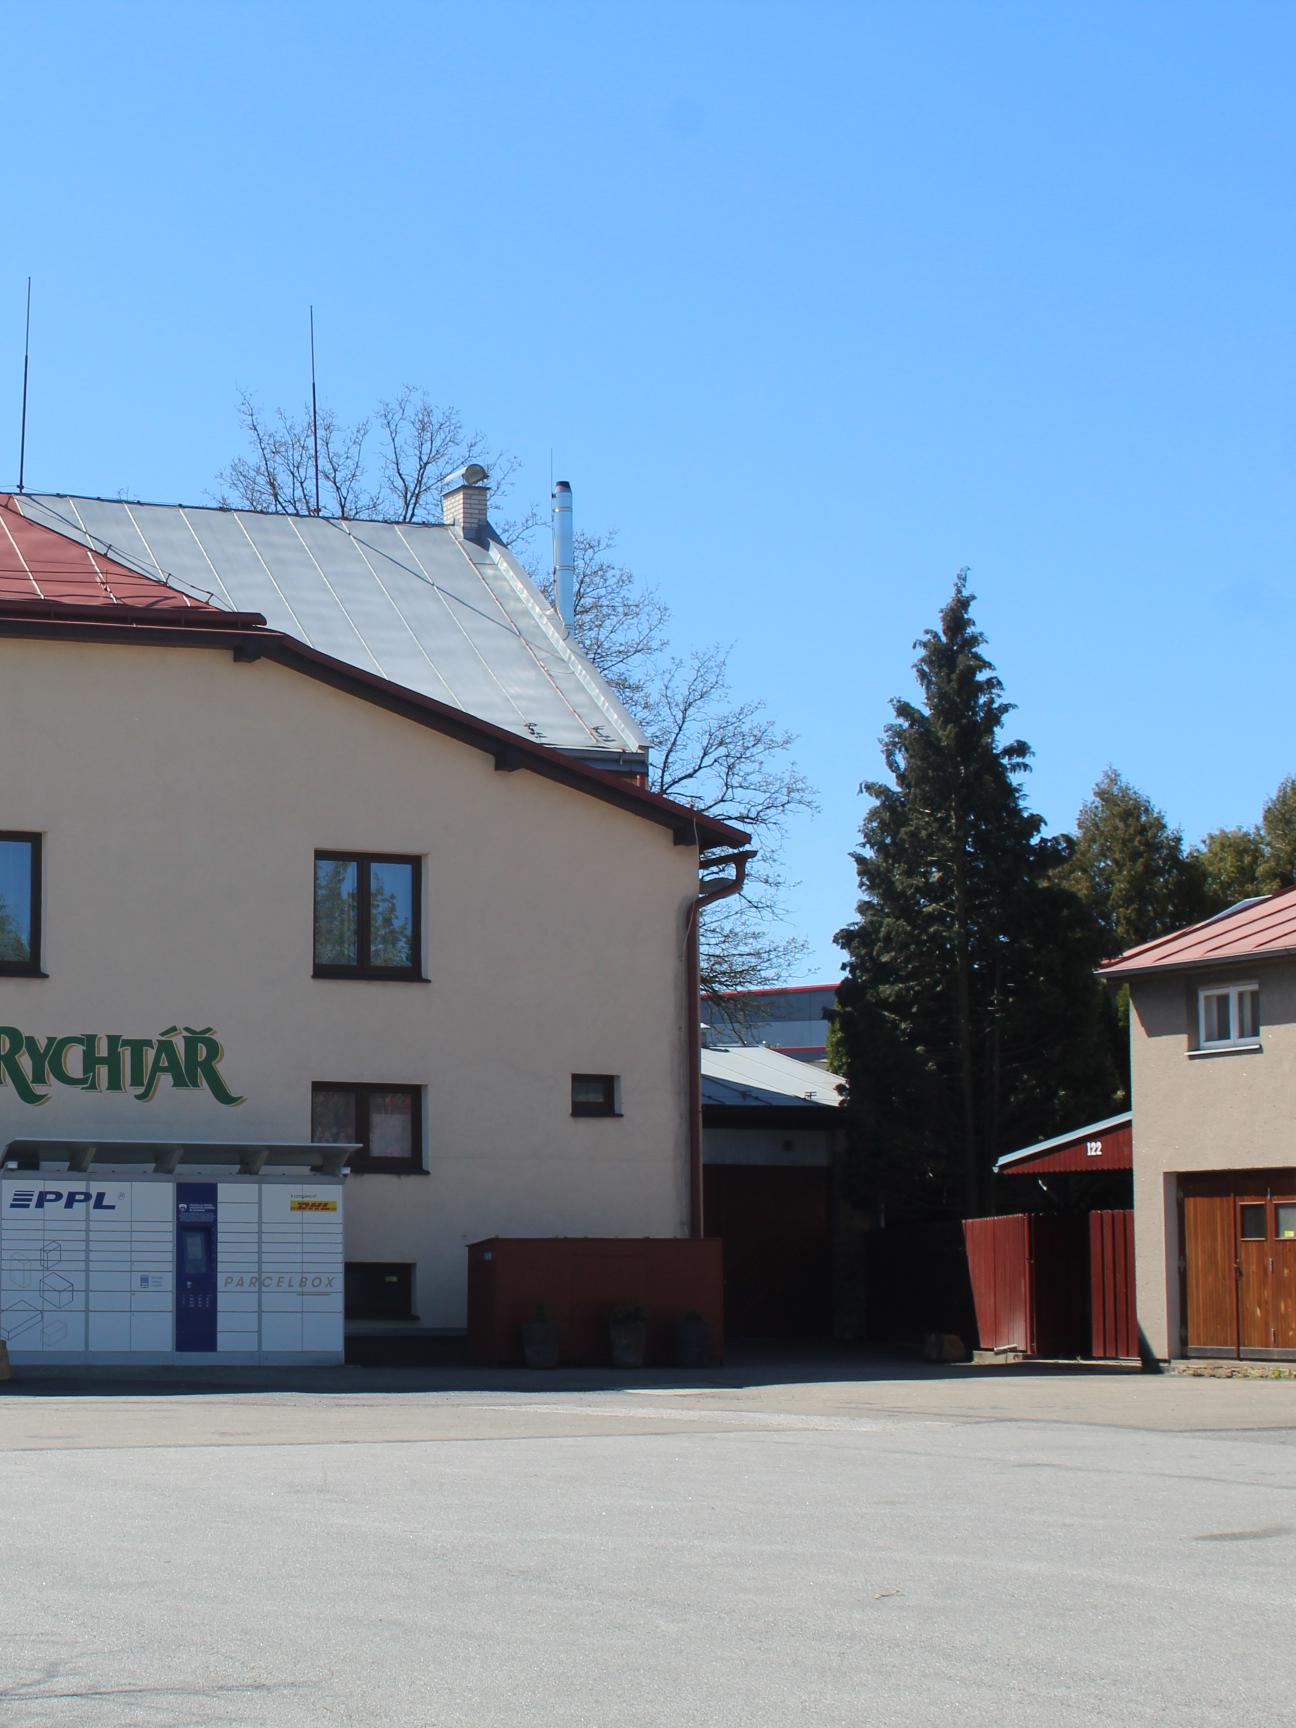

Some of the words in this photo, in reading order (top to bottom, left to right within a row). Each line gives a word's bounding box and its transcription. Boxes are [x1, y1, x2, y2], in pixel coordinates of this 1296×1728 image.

[1086, 1141, 1103, 1156] 122
[297, 1202, 330, 1212] DHL
[223, 1276, 336, 1288] PARCELBOX
